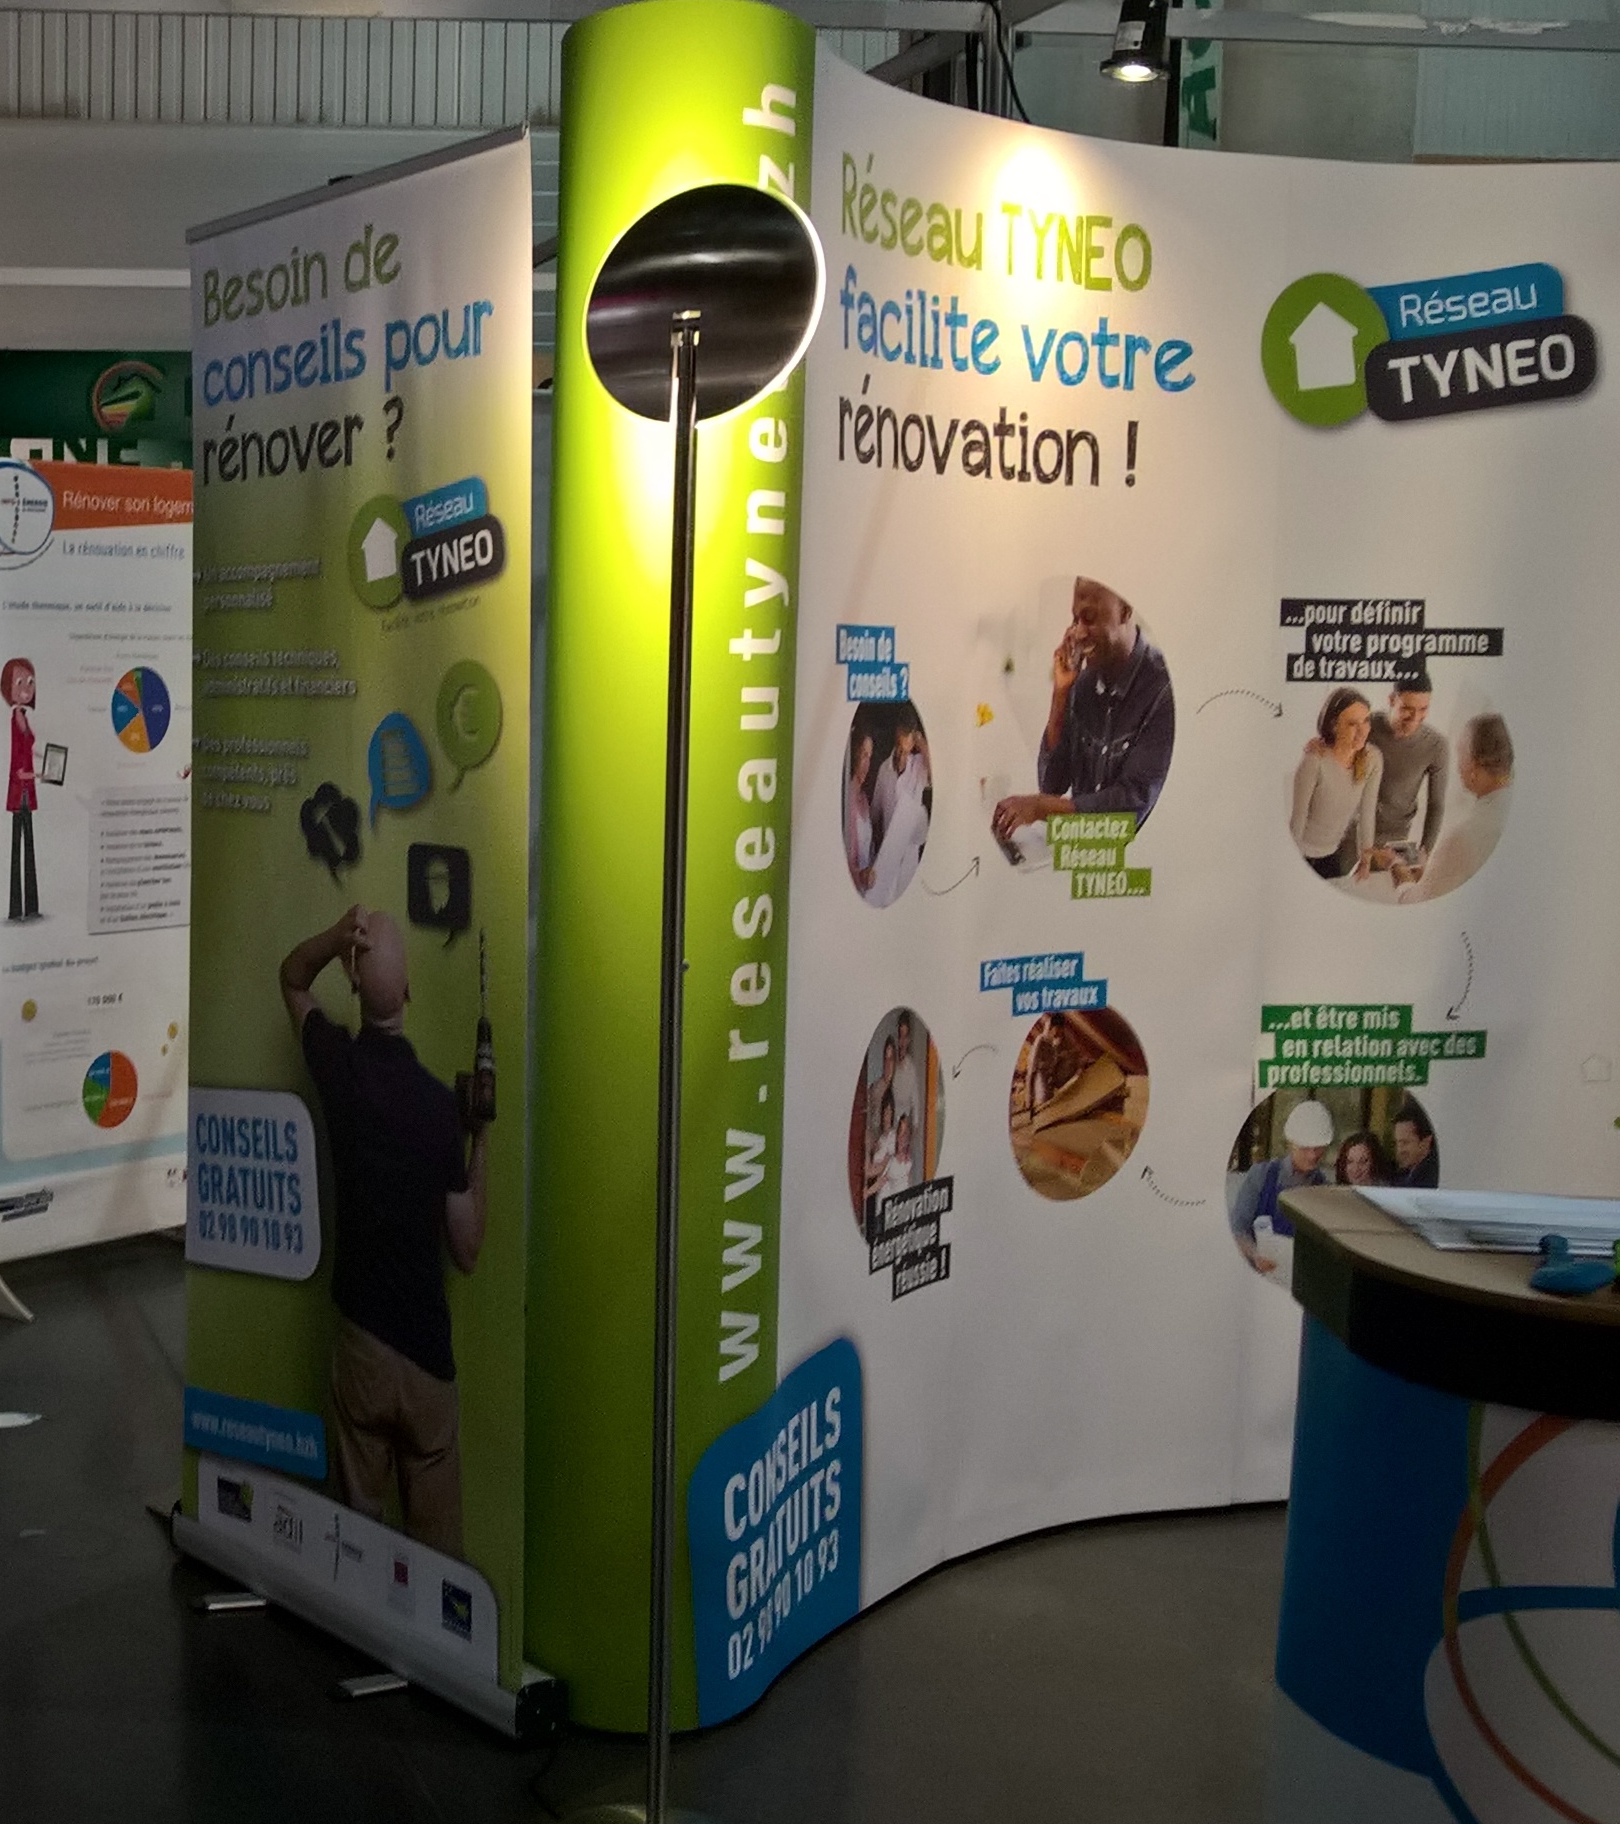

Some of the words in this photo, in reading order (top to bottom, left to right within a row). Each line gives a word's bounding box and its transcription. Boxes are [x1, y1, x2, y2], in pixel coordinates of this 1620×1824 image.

[841, 150, 983, 271] Réseau
[1000, 200, 1153, 292] TYNEO
[203, 246, 329, 328] Besoin
[343, 222, 402, 293] de
[1398, 283, 1538, 328] Réseau
[840, 263, 1001, 376] facilite
[1021, 317, 1196, 393] votre
[203, 318, 368, 407] conseils
[384, 299, 495, 393] pour
[1386, 333, 1577, 405] TYNEO
[203, 413, 365, 486] rénover
[383, 396, 404, 462] ?
[838, 373, 1100, 487] rénovation
[62, 490, 121, 512] Rénover
[124, 496, 151, 514] son
[414, 490, 474, 531] Réseau
[78, 540, 134, 558] rénovation
[409, 528, 495, 587] TYNEO
[1284, 603, 1348, 627] ...pour
[1350, 600, 1423, 626] définir
[839, 629, 876, 661] Besoin
[876, 633, 894, 661] de
[1311, 630, 1362, 652] votre
[1366, 632, 1490, 658] programme
[849, 671, 898, 699] conseils
[1292, 656, 1316, 680] de
[1318, 657, 1419, 680] travaux...
[1051, 815, 1130, 841] Contactez
[1060, 843, 1117, 869] Réseau
[983, 962, 1021, 987] Faites
[1021, 956, 1079, 981] réaliser
[1015, 990, 1040, 1012] vos
[1042, 983, 1099, 1009] travaux
[1315, 1004, 1359, 1030] être
[1362, 1006, 1401, 1030] mis
[1282, 1038, 1308, 1059] en
[1312, 1035, 1393, 1059] relation
[1396, 1038, 1442, 1057] avec
[1443, 1034, 1477, 1055] des
[1267, 1060, 1423, 1087] professionnels.
[195, 1112, 299, 1165] CONSEILS
[197, 1162, 303, 1217] GRATUITS
[198, 1209, 216, 1241] 02
[262, 1217, 281, 1251] 10
[723, 1386, 842, 1542] CONSEILS
[725, 1459, 842, 1621] GRATUITS
[727, 1622, 755, 1681] 02
[794, 1549, 814, 1603] 10
[817, 1529, 840, 1583] 93
